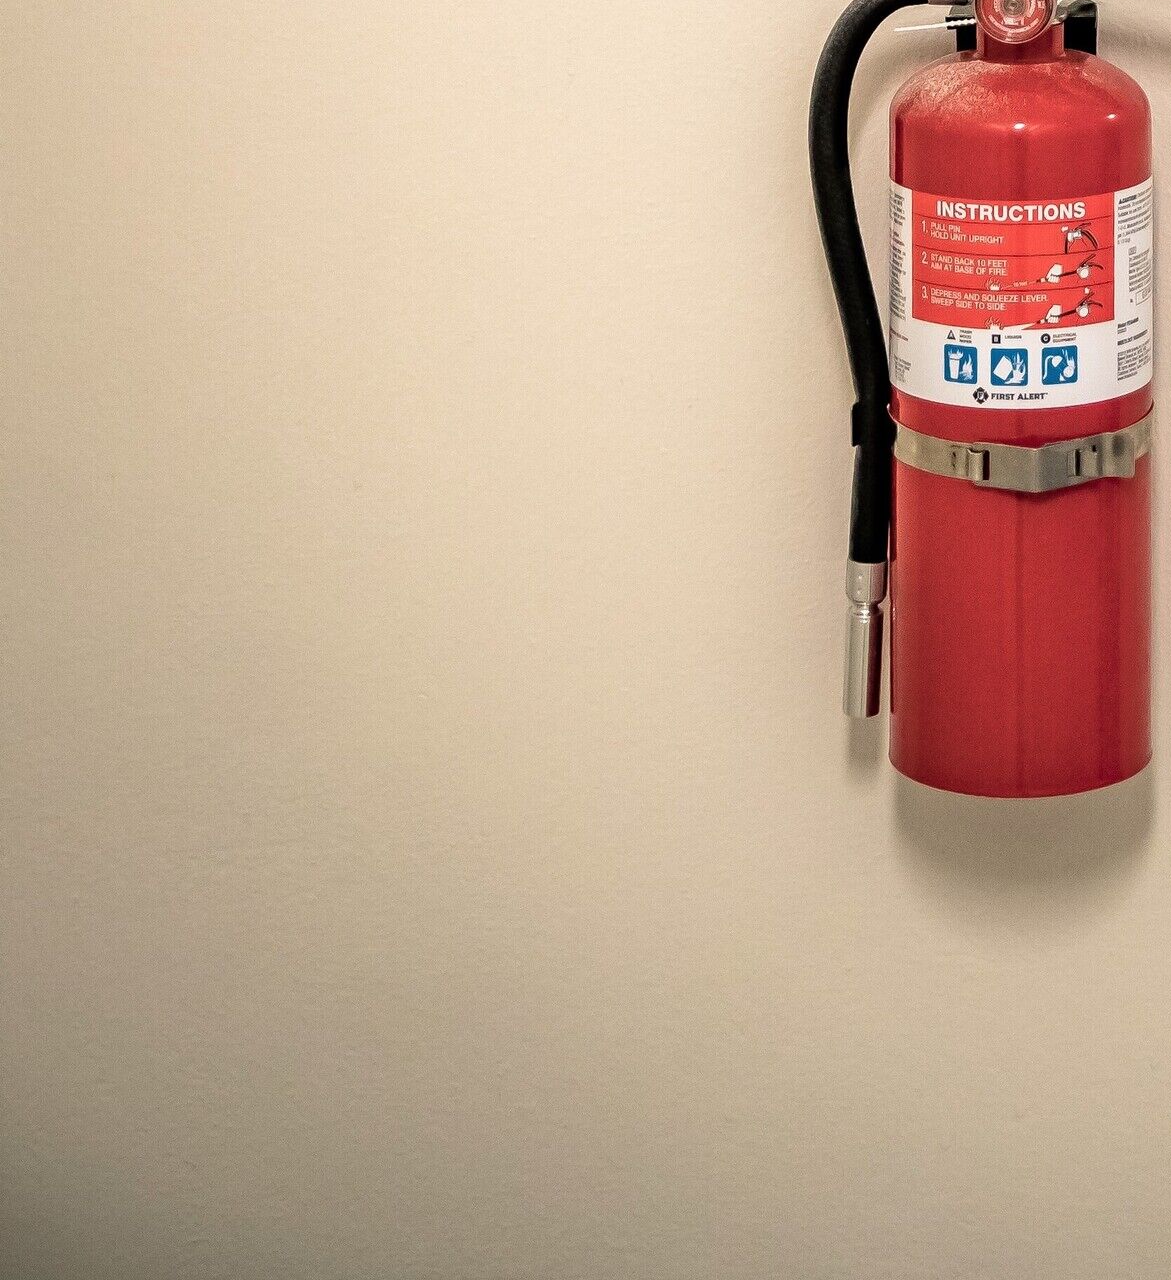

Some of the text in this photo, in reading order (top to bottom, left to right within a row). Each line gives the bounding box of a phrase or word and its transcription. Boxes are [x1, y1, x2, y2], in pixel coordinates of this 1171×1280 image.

[936, 201, 1086, 222] INSTRUCTIONS
[931, 222, 947, 231] PULL
[930, 230, 1004, 244] HOLD UNIT UPRIGHT
[930, 253, 953, 264] STAND
[954, 256, 975, 266] BACK
[977, 259, 986, 267] 10
[987, 259, 1008, 268] FEET
[930, 262, 943, 270] AIM
[954, 265, 974, 274] BASE
[976, 267, 986, 275] OF
[930, 288, 962, 300] DEPRESS
[963, 293, 980, 301] AND
[981, 294, 1019, 302] SQUEEZE
[930, 296, 954, 307] SWEEP
[956, 300, 973, 308] SIDE
[974, 302, 985, 310] TO
